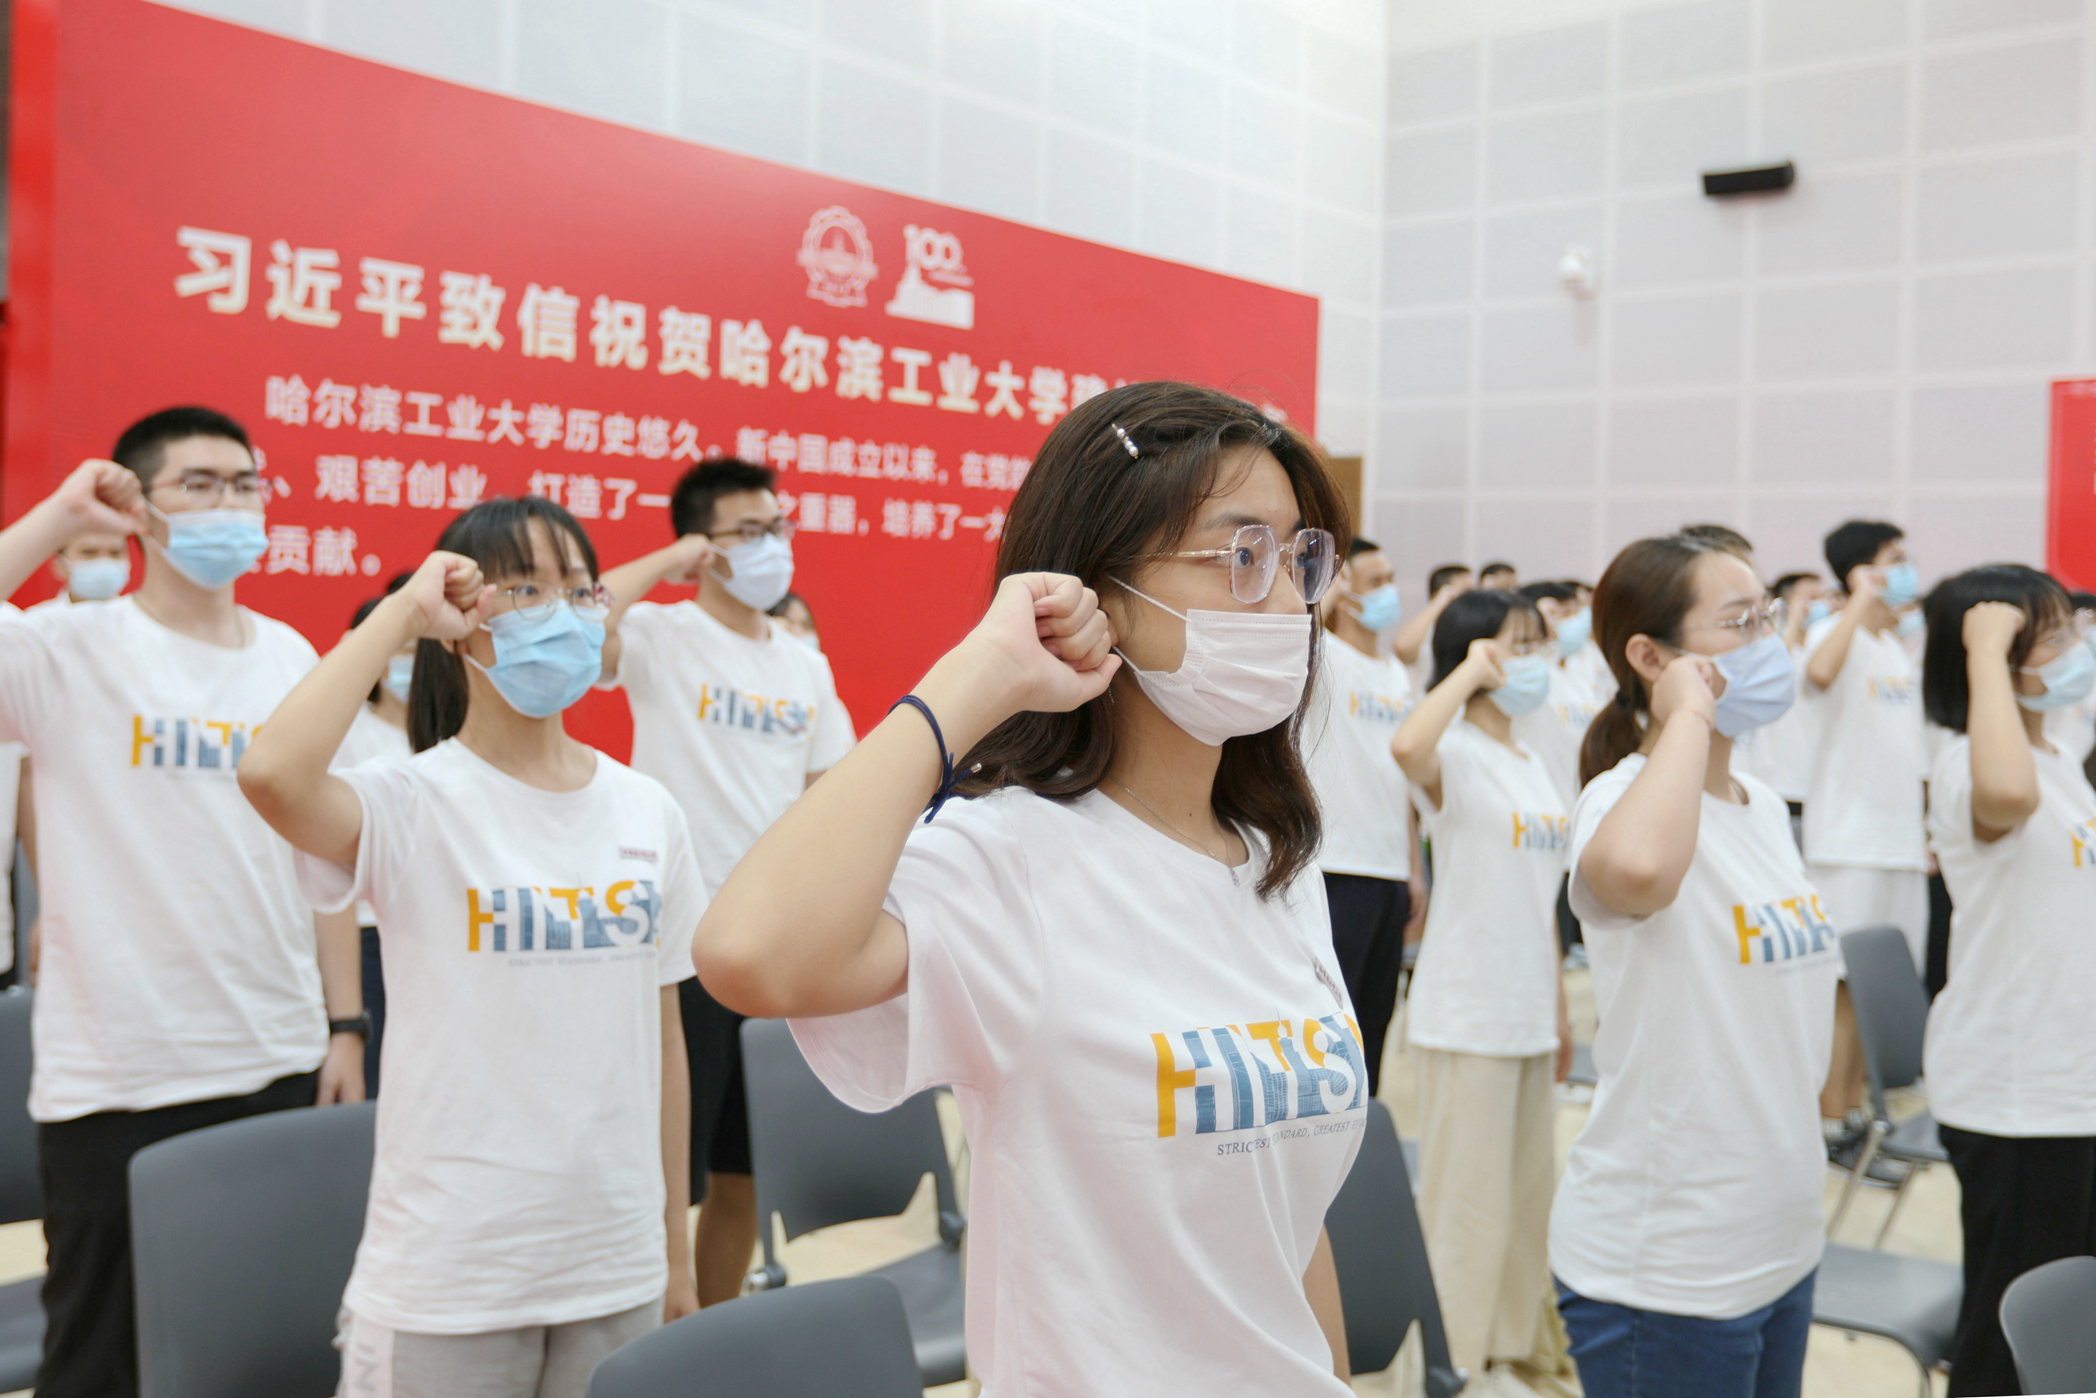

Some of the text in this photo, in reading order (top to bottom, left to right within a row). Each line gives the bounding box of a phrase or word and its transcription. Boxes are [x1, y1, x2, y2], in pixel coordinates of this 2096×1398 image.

[175, 226, 1138, 425] 习近平致信祝贺哈尔滨工业大学
[250, 523, 381, 577] 贡献。
[131, 715, 265, 768] HIT
